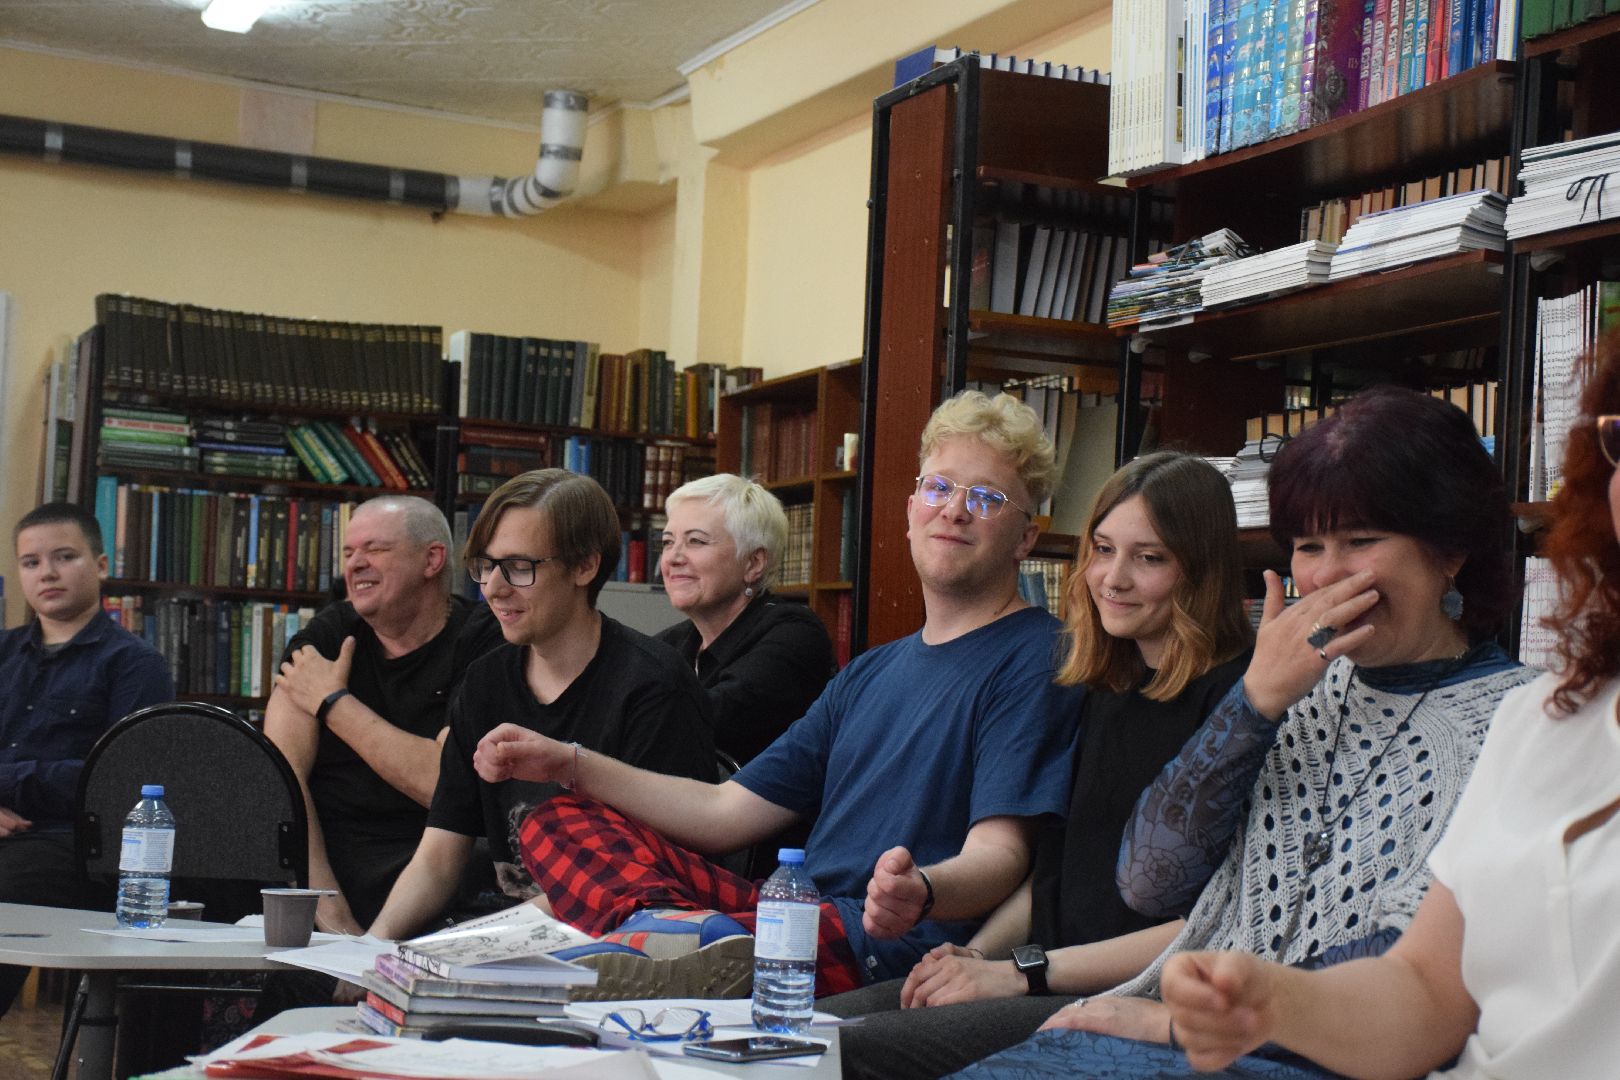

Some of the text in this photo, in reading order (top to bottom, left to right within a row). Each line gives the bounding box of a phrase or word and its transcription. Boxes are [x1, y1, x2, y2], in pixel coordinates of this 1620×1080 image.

[1363, 17, 1372, 46] МИР
[1374, 20, 1385, 49] МИР
[1387, 28, 1398, 61] ВЕСЬ
[1402, 22, 1414, 56] ВЕСЬ
[1416, 22, 1428, 56] ВЕСЬ
[1361, 47, 1371, 79] ВЕСЬ
[1371, 49, 1383, 81] ВЕСЬ
